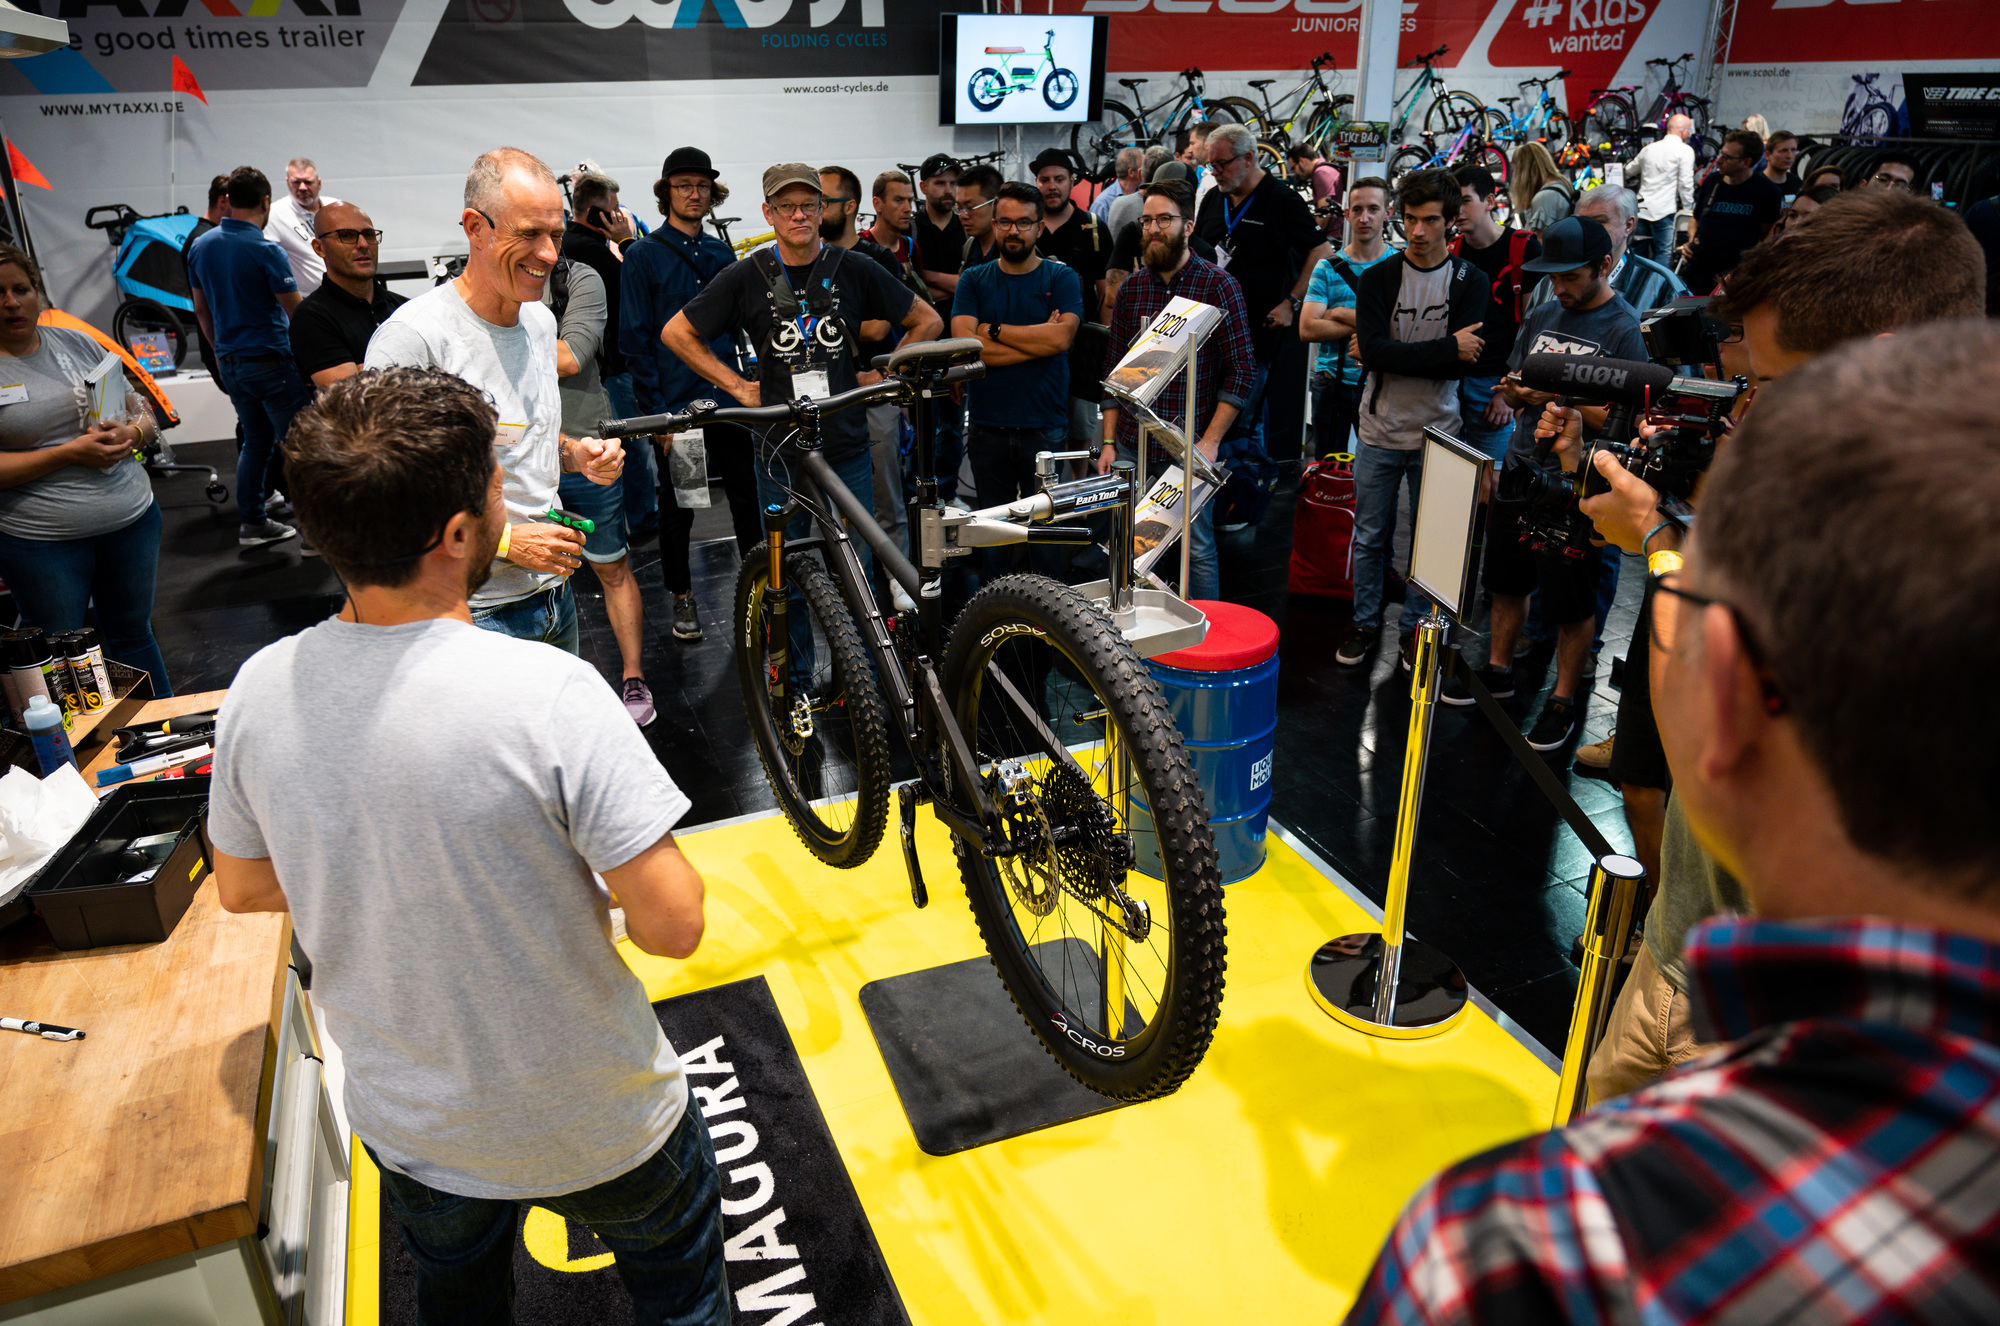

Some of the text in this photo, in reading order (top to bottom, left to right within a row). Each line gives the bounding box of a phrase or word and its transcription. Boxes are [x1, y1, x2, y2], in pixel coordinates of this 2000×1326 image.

[1291, 18, 1359, 32] JUNIOR
[94, 26, 176, 56] good
[184, 25, 270, 49] times
[278, 24, 365, 48] trailer
[761, 33, 888, 48] FOLDING CYCLES
[1549, 29, 1626, 54] wanted
[1727, 67, 1791, 78] www.scool.de
[783, 81, 889, 95] www.coast-cycles.de
[1945, 87, 1987, 100] TIRE
[40, 102, 185, 116] WWW.MYTAXXI.DE
[1340, 131, 1379, 144] TIKI BAR
[1152, 313, 1187, 338] 2020
[1561, 362, 1628, 389] RØDE
[1148, 481, 1183, 509] 2020
[745, 580, 757, 648] ACROS
[980, 623, 1047, 648] ACROS
[1051, 1015, 1125, 1057] ACROS
[679, 1034, 824, 1326] MAGURA
